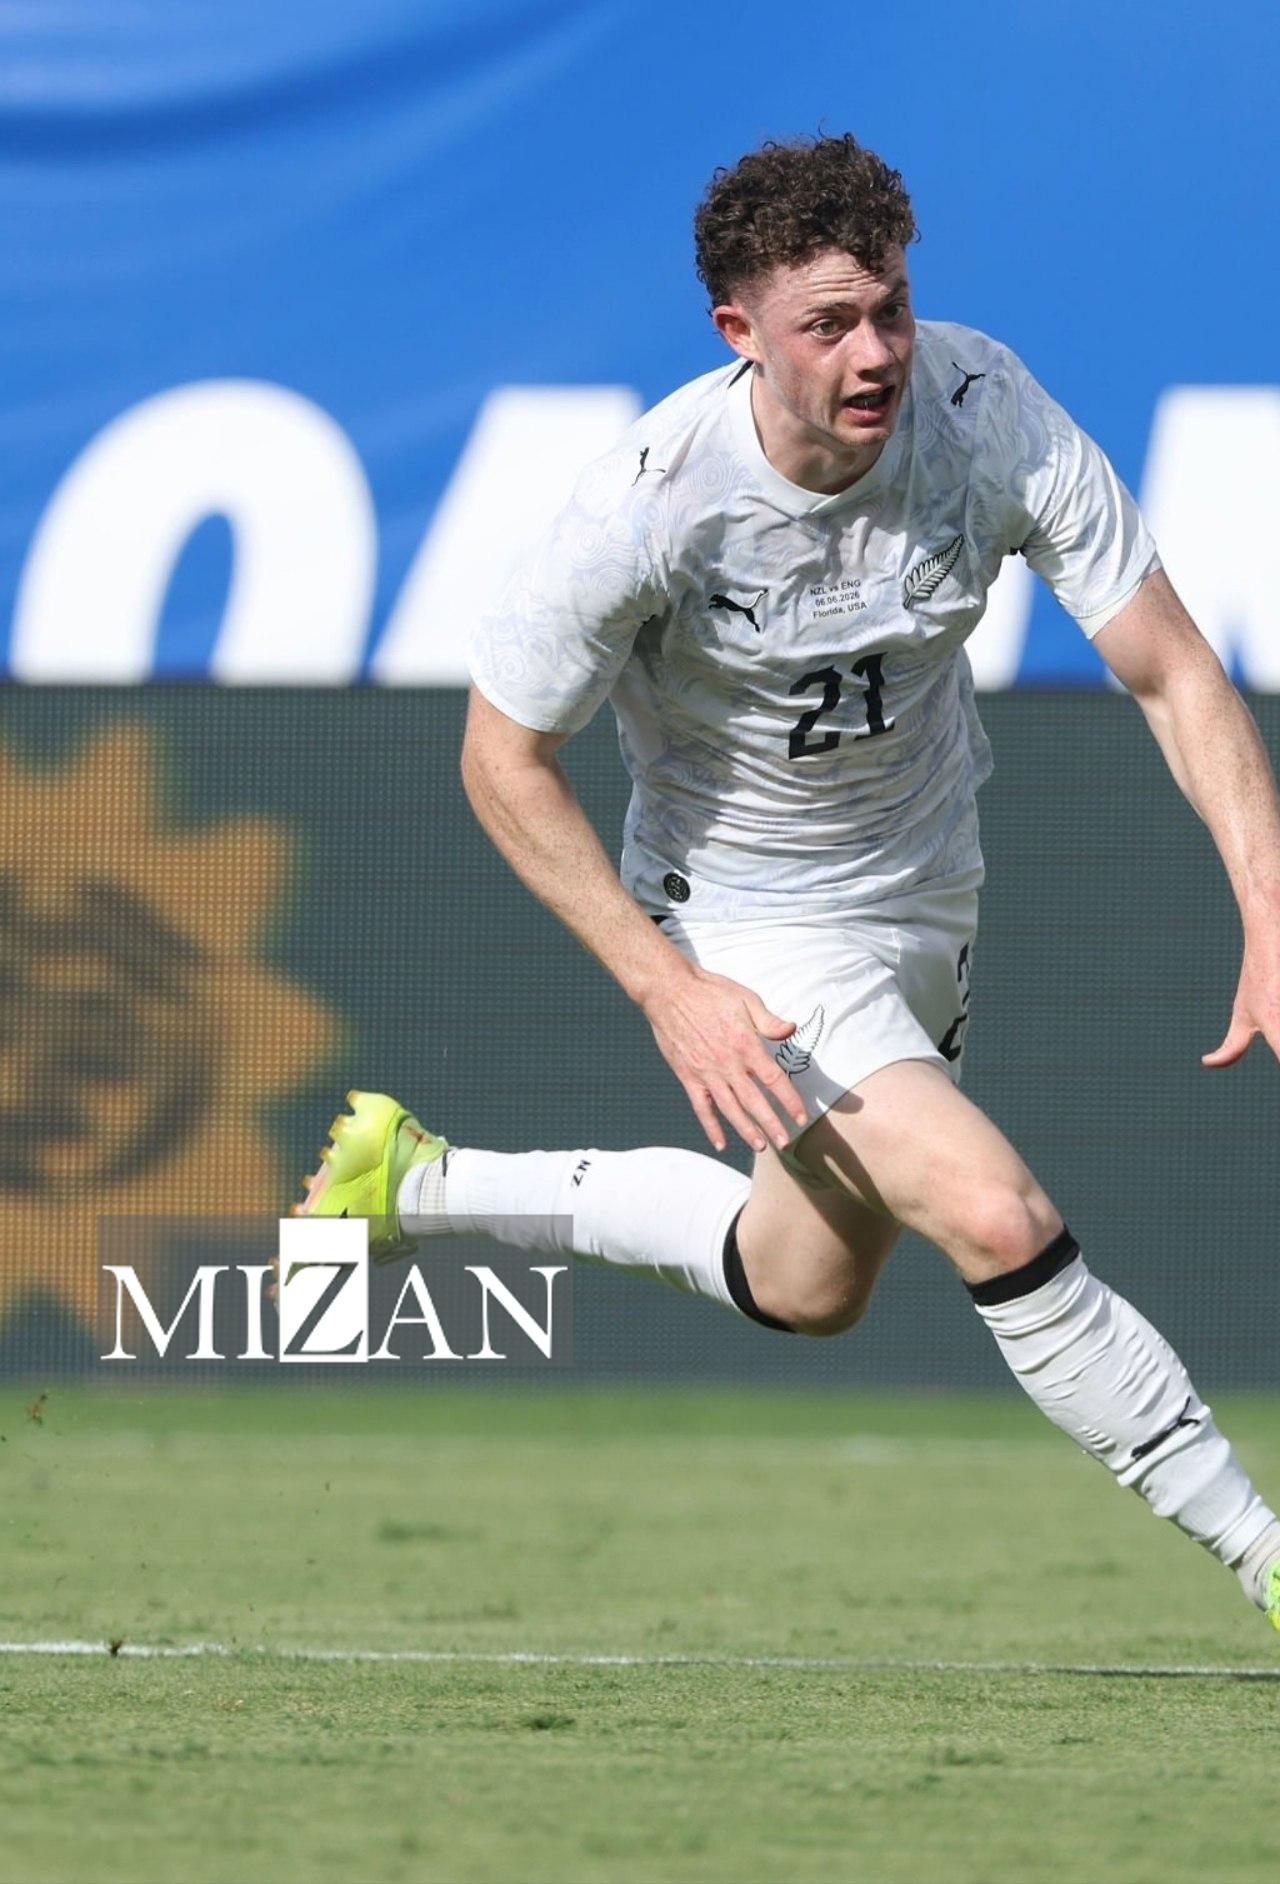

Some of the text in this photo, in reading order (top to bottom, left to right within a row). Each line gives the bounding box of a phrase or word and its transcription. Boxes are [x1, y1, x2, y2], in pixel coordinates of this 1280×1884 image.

[809, 579, 861, 596] NZL vs ENG
[813, 601, 867, 619] Florida, USA
[788, 651, 896, 760] 21
